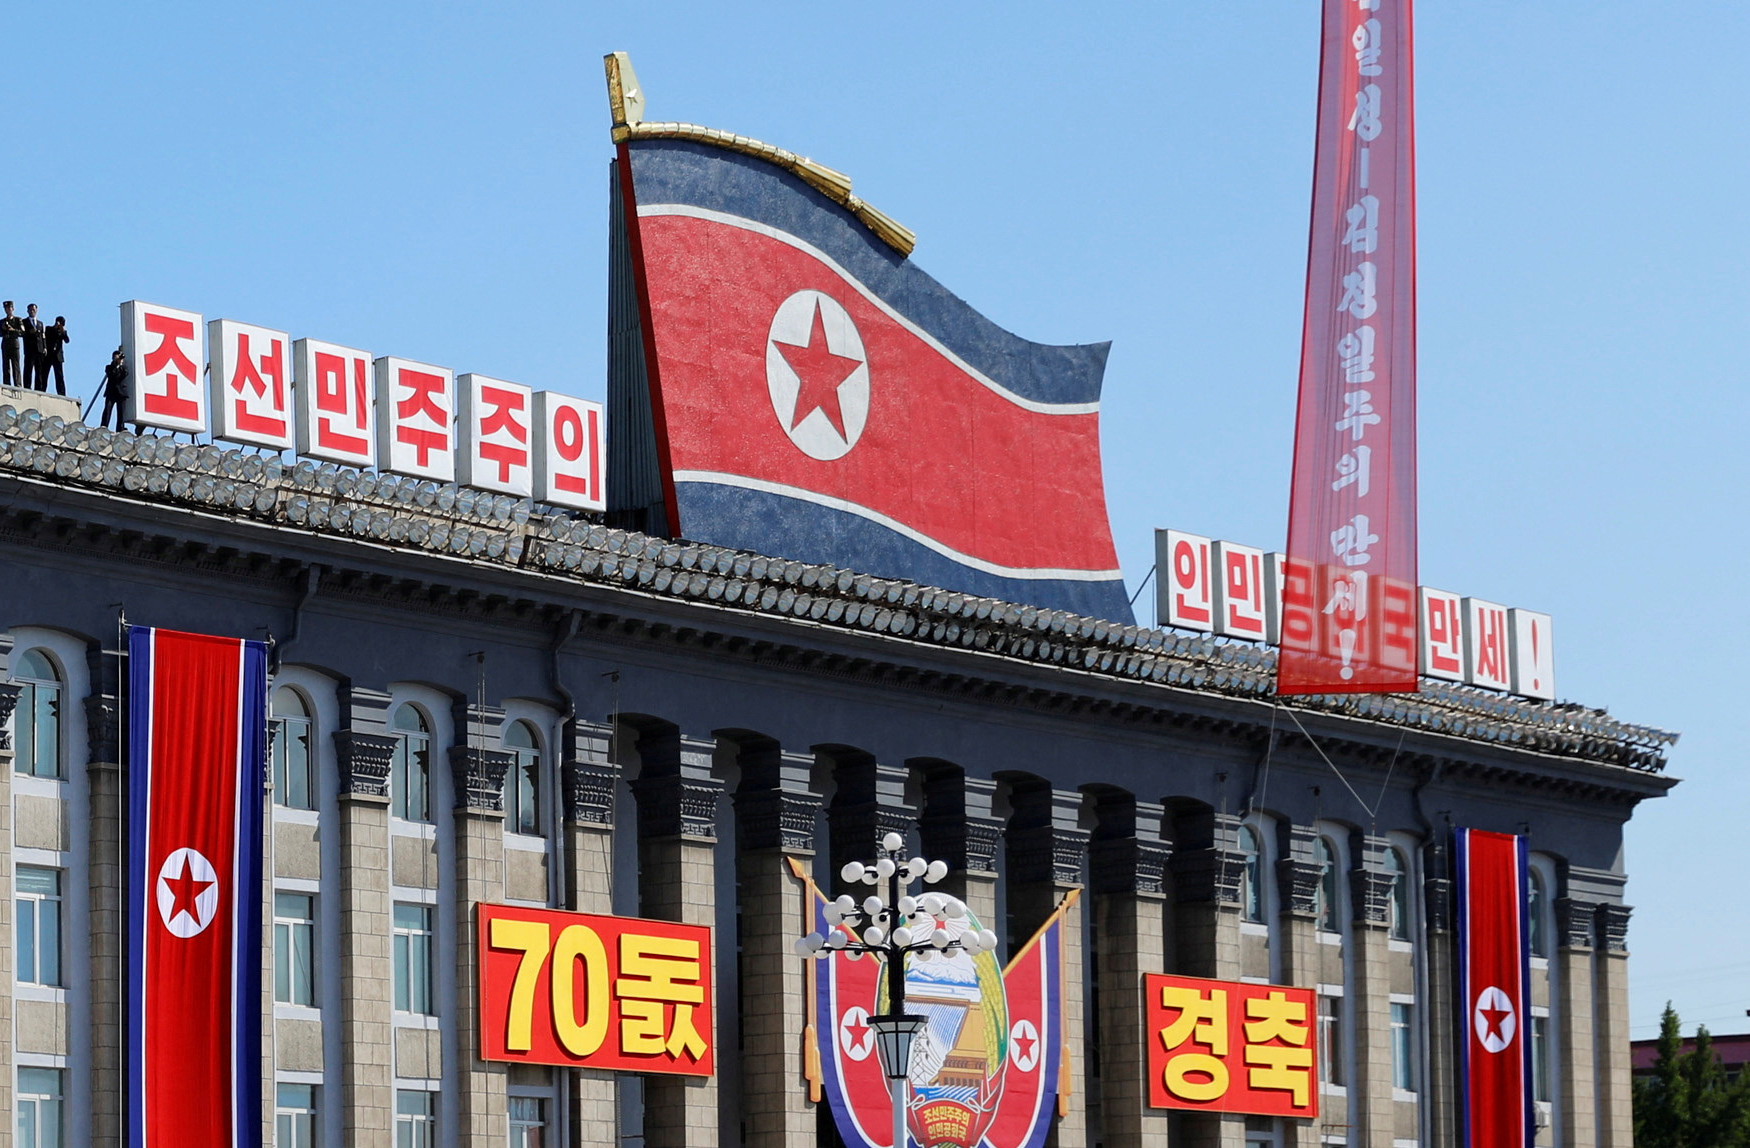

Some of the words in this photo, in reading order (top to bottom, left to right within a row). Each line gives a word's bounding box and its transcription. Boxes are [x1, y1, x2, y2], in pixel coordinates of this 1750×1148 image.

[1332, 0, 1383, 497] 일성-김정일주의
[144, 312, 600, 502] 조선민주주의
[1428, 596, 1539, 691] 만세!
[1321, 515, 1379, 680] 만세!
[491, 918, 708, 1061] 70돐
[1160, 986, 1313, 1106] 경축
[923, 1106, 970, 1127] 조선민주주의
[928, 1122, 967, 1141] 인민공화국
